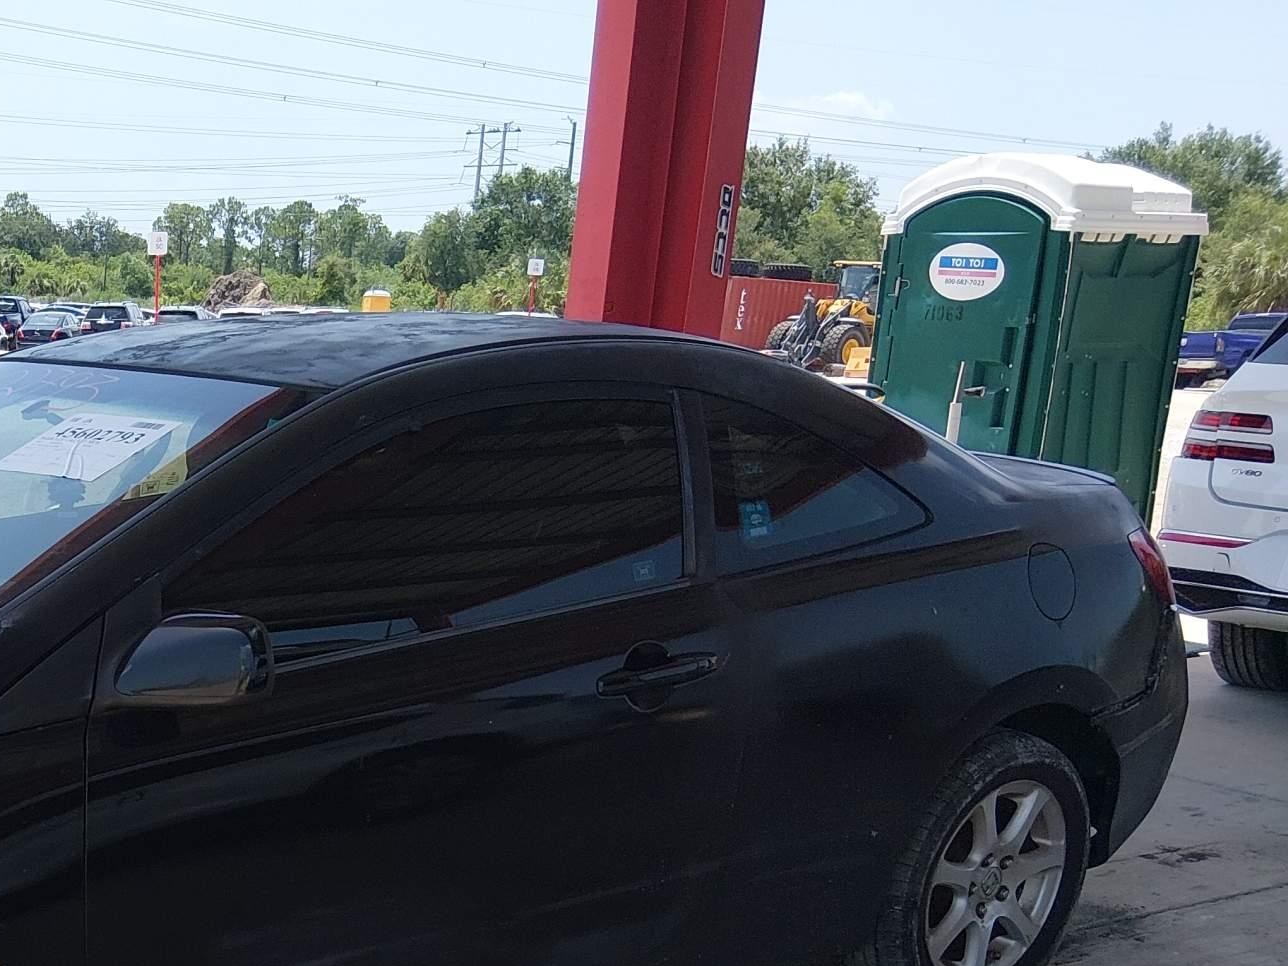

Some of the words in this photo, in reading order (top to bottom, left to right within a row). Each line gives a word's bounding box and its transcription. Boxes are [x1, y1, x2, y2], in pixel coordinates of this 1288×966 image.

[951, 258, 966, 267] TOI
[969, 259, 985, 268] TOI
[55, 427, 146, 444] 45602793
